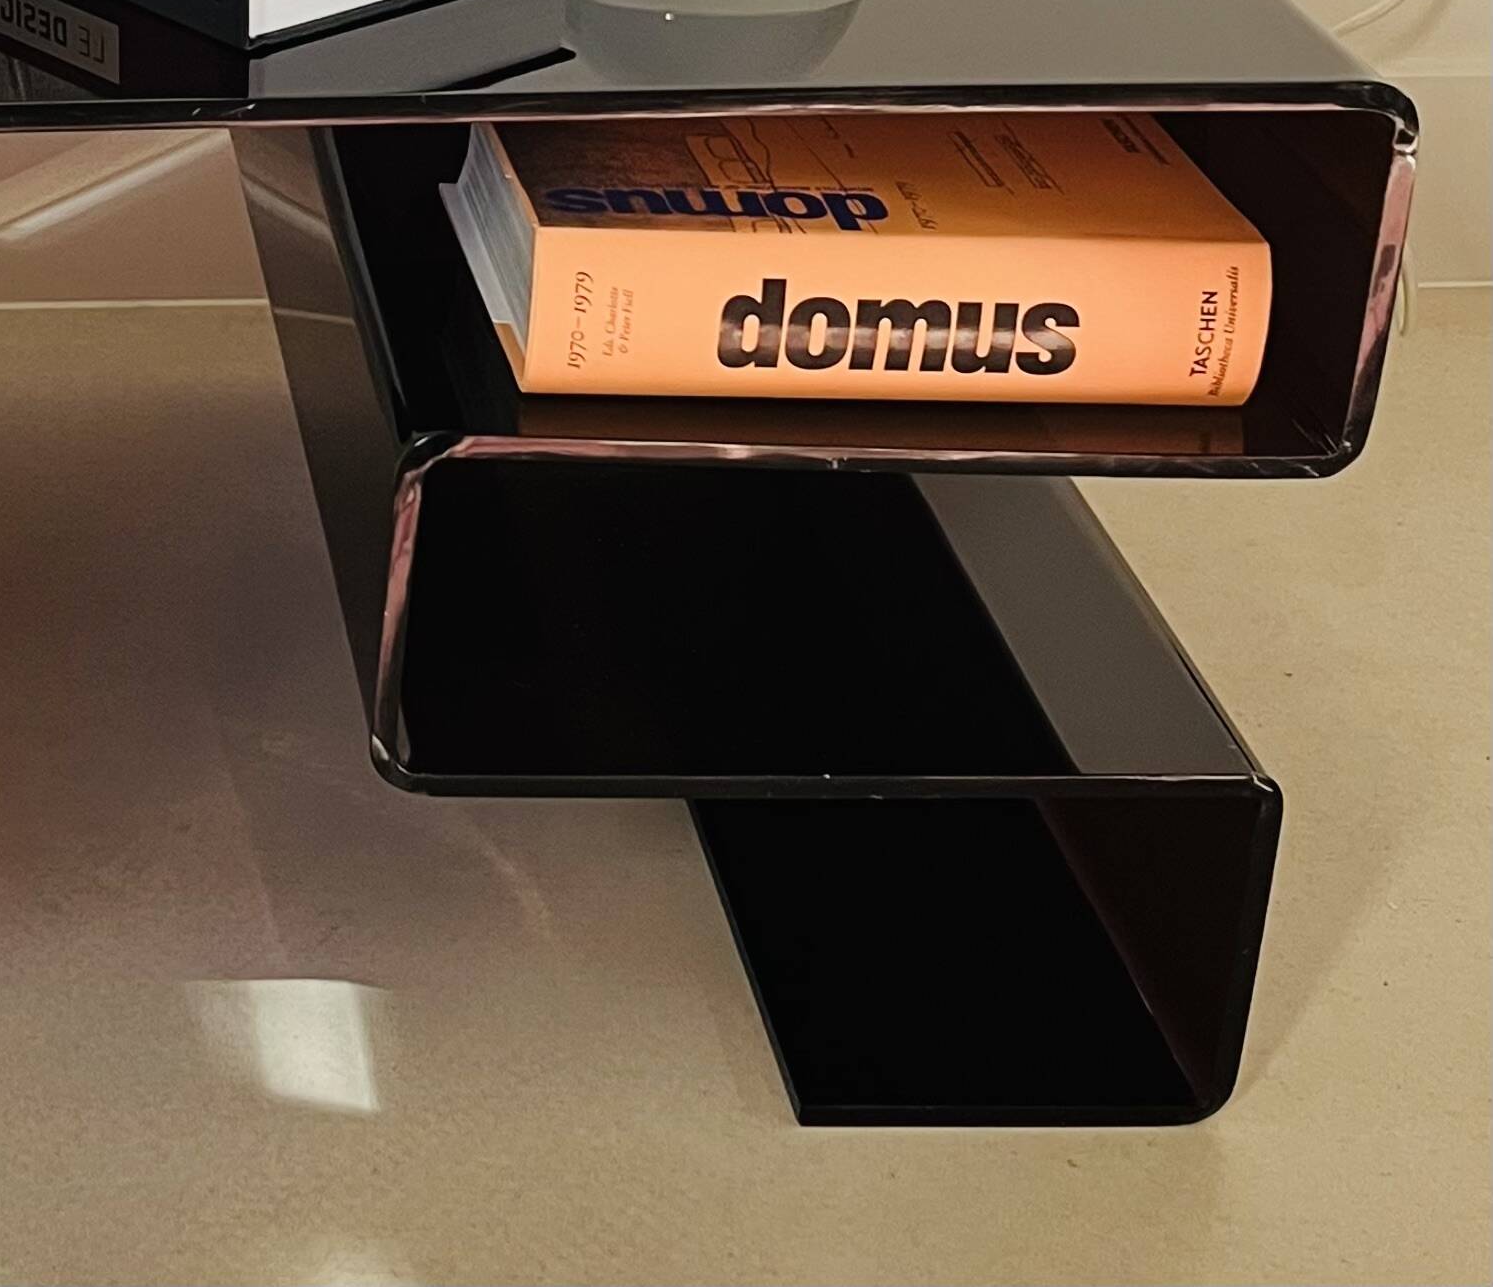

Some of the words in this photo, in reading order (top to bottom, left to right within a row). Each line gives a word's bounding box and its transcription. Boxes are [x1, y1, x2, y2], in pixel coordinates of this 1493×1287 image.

[545, 188, 888, 230] domus
[717, 278, 1080, 375] domus
[1189, 291, 1218, 377] TASCHEN
[1207, 337, 1233, 396] Bibliotheca
[1223, 265, 1239, 334] Universalis
